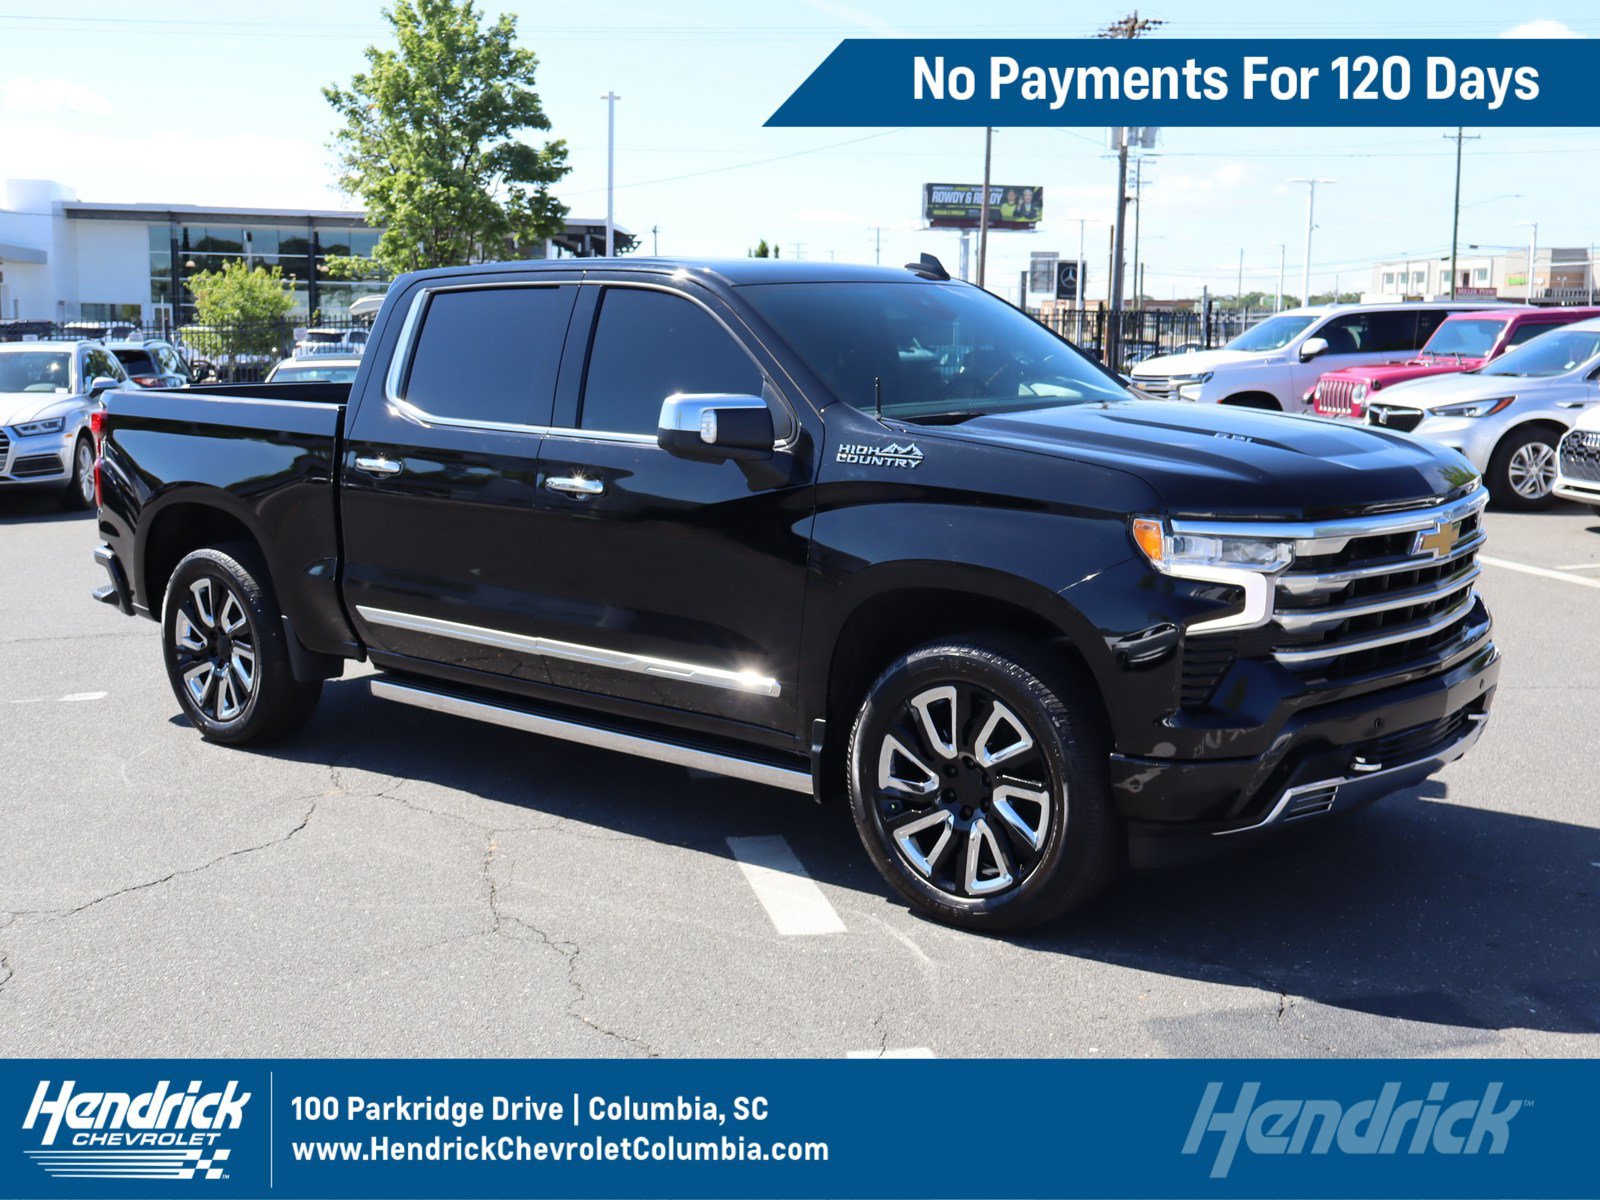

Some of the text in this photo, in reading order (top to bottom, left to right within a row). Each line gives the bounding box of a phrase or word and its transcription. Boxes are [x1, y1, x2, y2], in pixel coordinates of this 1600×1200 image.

[932, 190, 965, 204] ROWDY
[973, 191, 1003, 205] REDY
[838, 443, 881, 455] HIGH
[836, 453, 922, 469] COUNTRY
